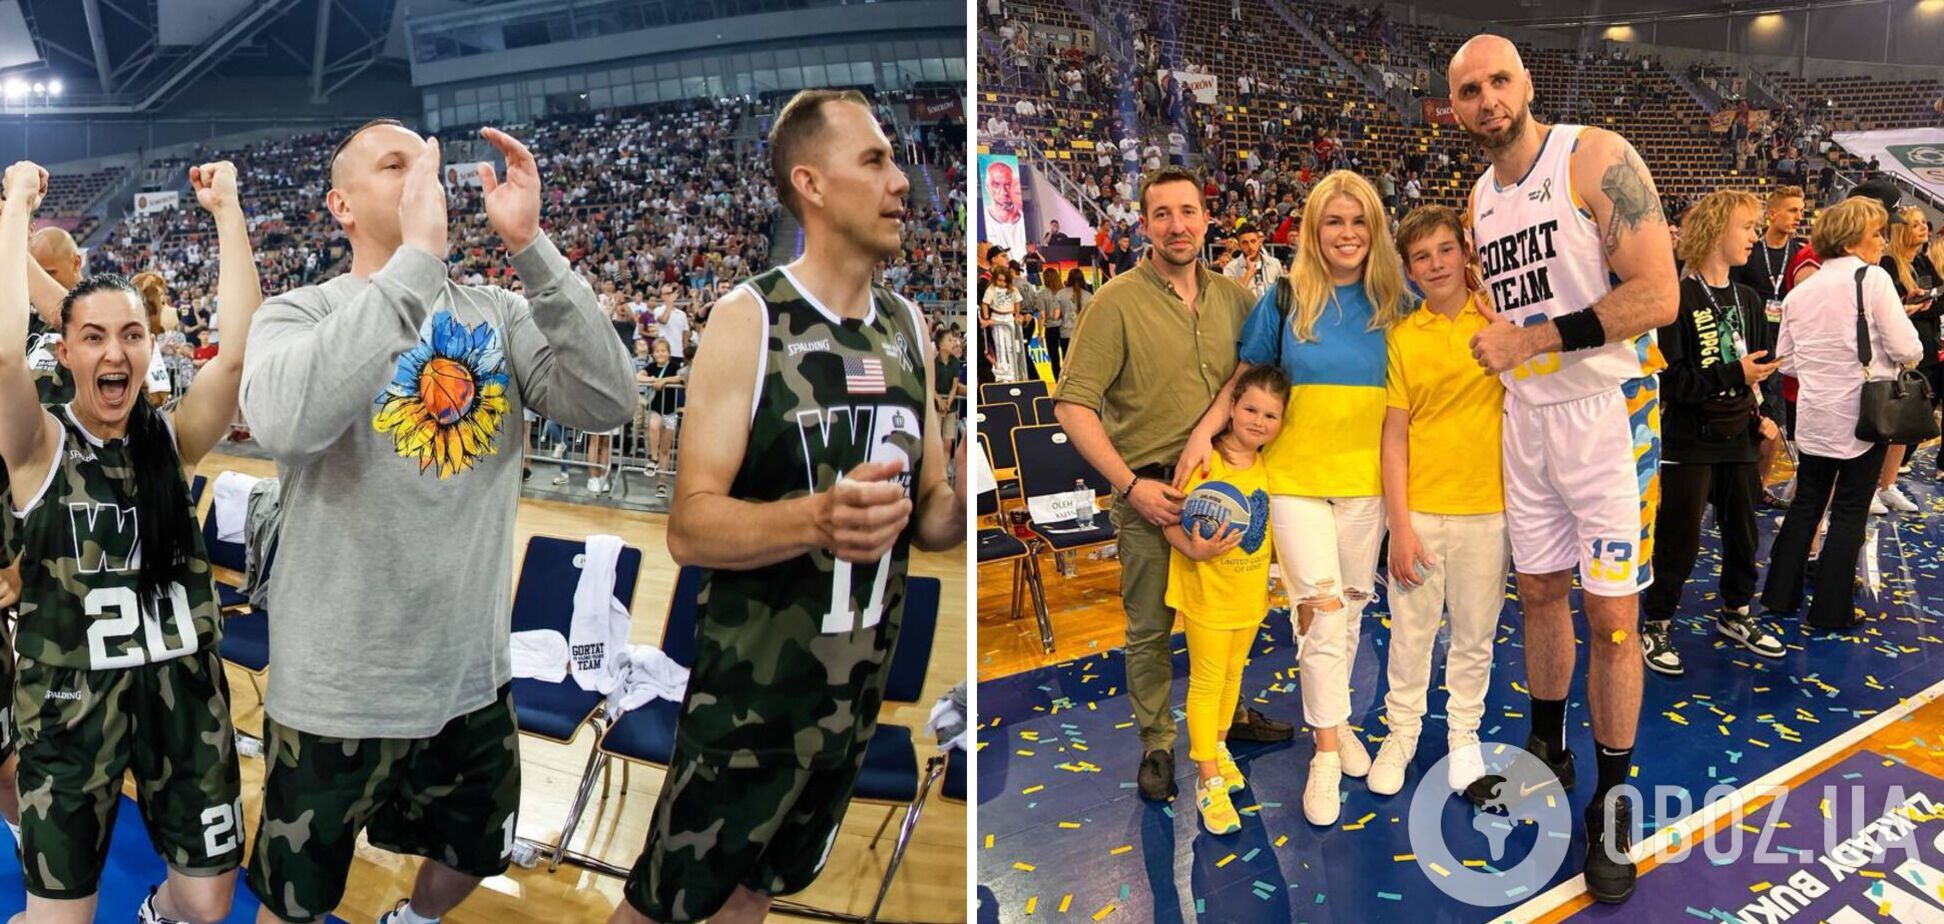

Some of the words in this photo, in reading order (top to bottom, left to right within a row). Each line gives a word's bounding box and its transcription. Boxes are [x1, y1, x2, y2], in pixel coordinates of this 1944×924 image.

[1478, 219, 1558, 282] GORTAT
[1491, 265, 1554, 313] TEAM
[788, 338, 830, 357] SPALDING
[1698, 330, 1720, 357] PPG
[1051, 499, 1073, 510] OLEH
[69, 502, 143, 573] W
[1590, 539, 1632, 581] 13
[84, 581, 199, 671] 20
[572, 642, 604, 656] GORTAT
[577, 659, 601, 671] TEAM
